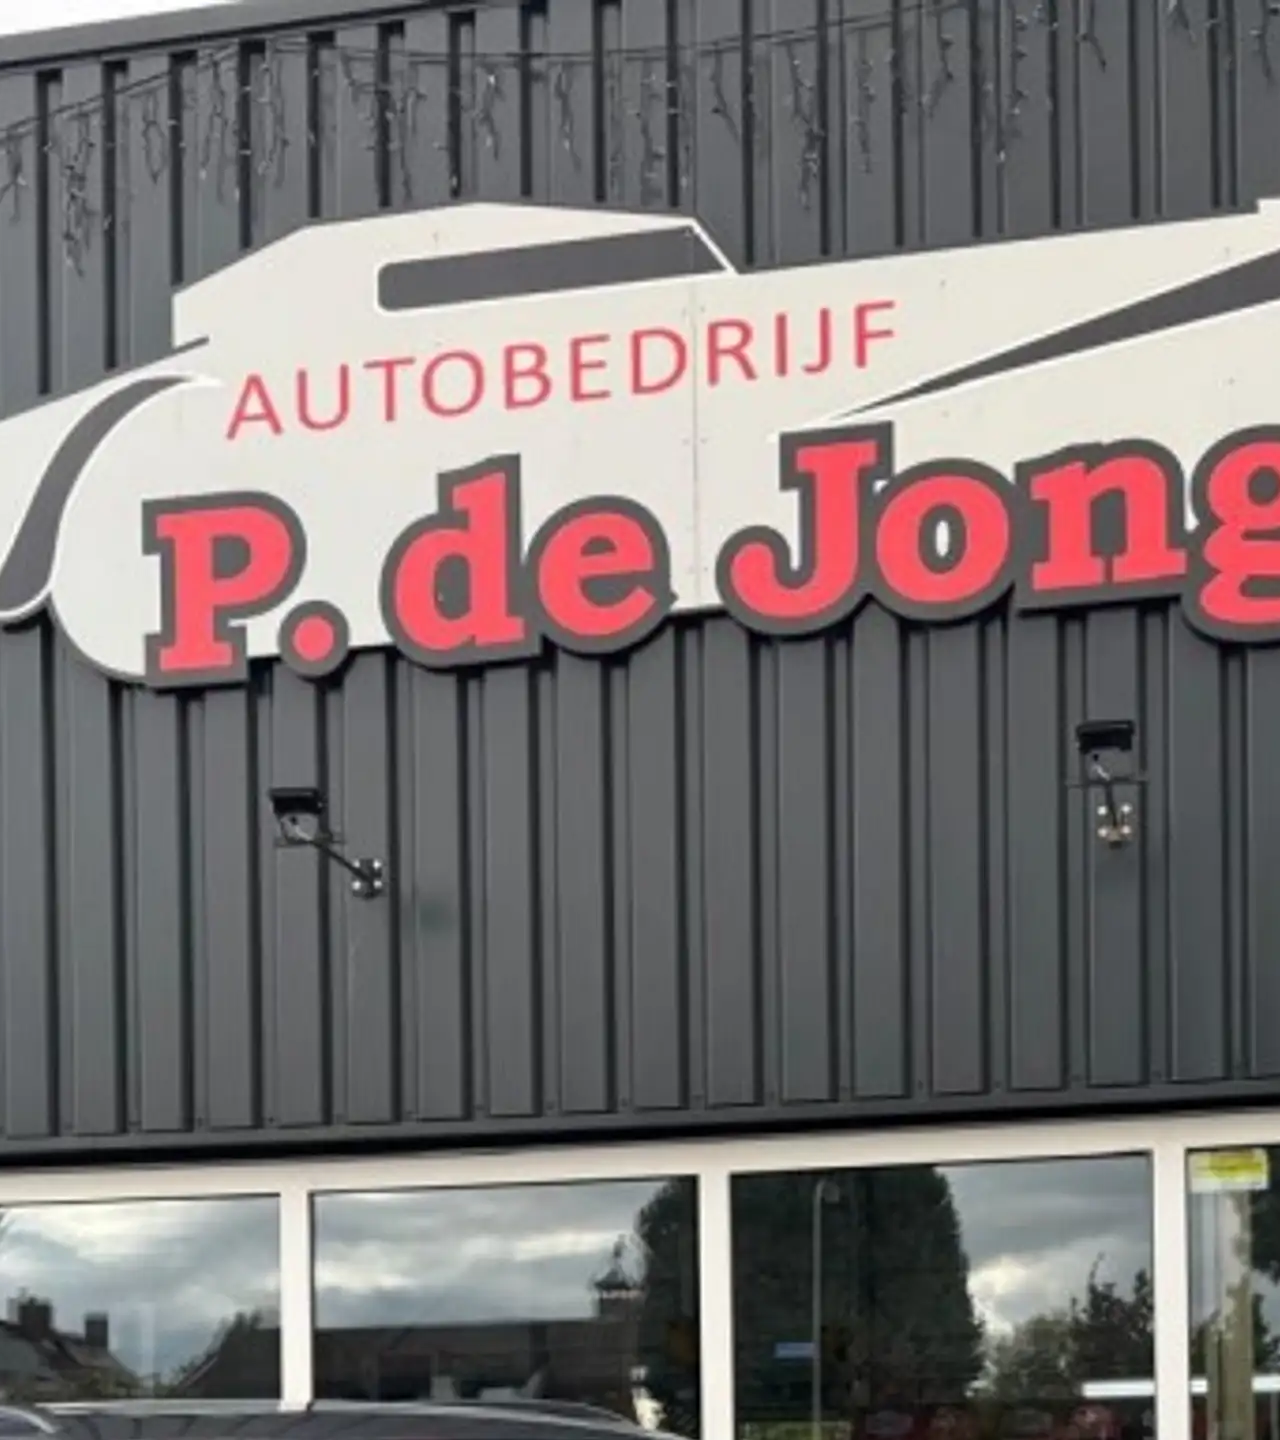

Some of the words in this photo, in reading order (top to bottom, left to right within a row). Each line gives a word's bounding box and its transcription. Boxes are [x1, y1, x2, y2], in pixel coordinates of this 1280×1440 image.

[225, 300, 895, 441] AUTOBEDRIJF
[152, 500, 338, 676] P.
[390, 467, 660, 655] de
